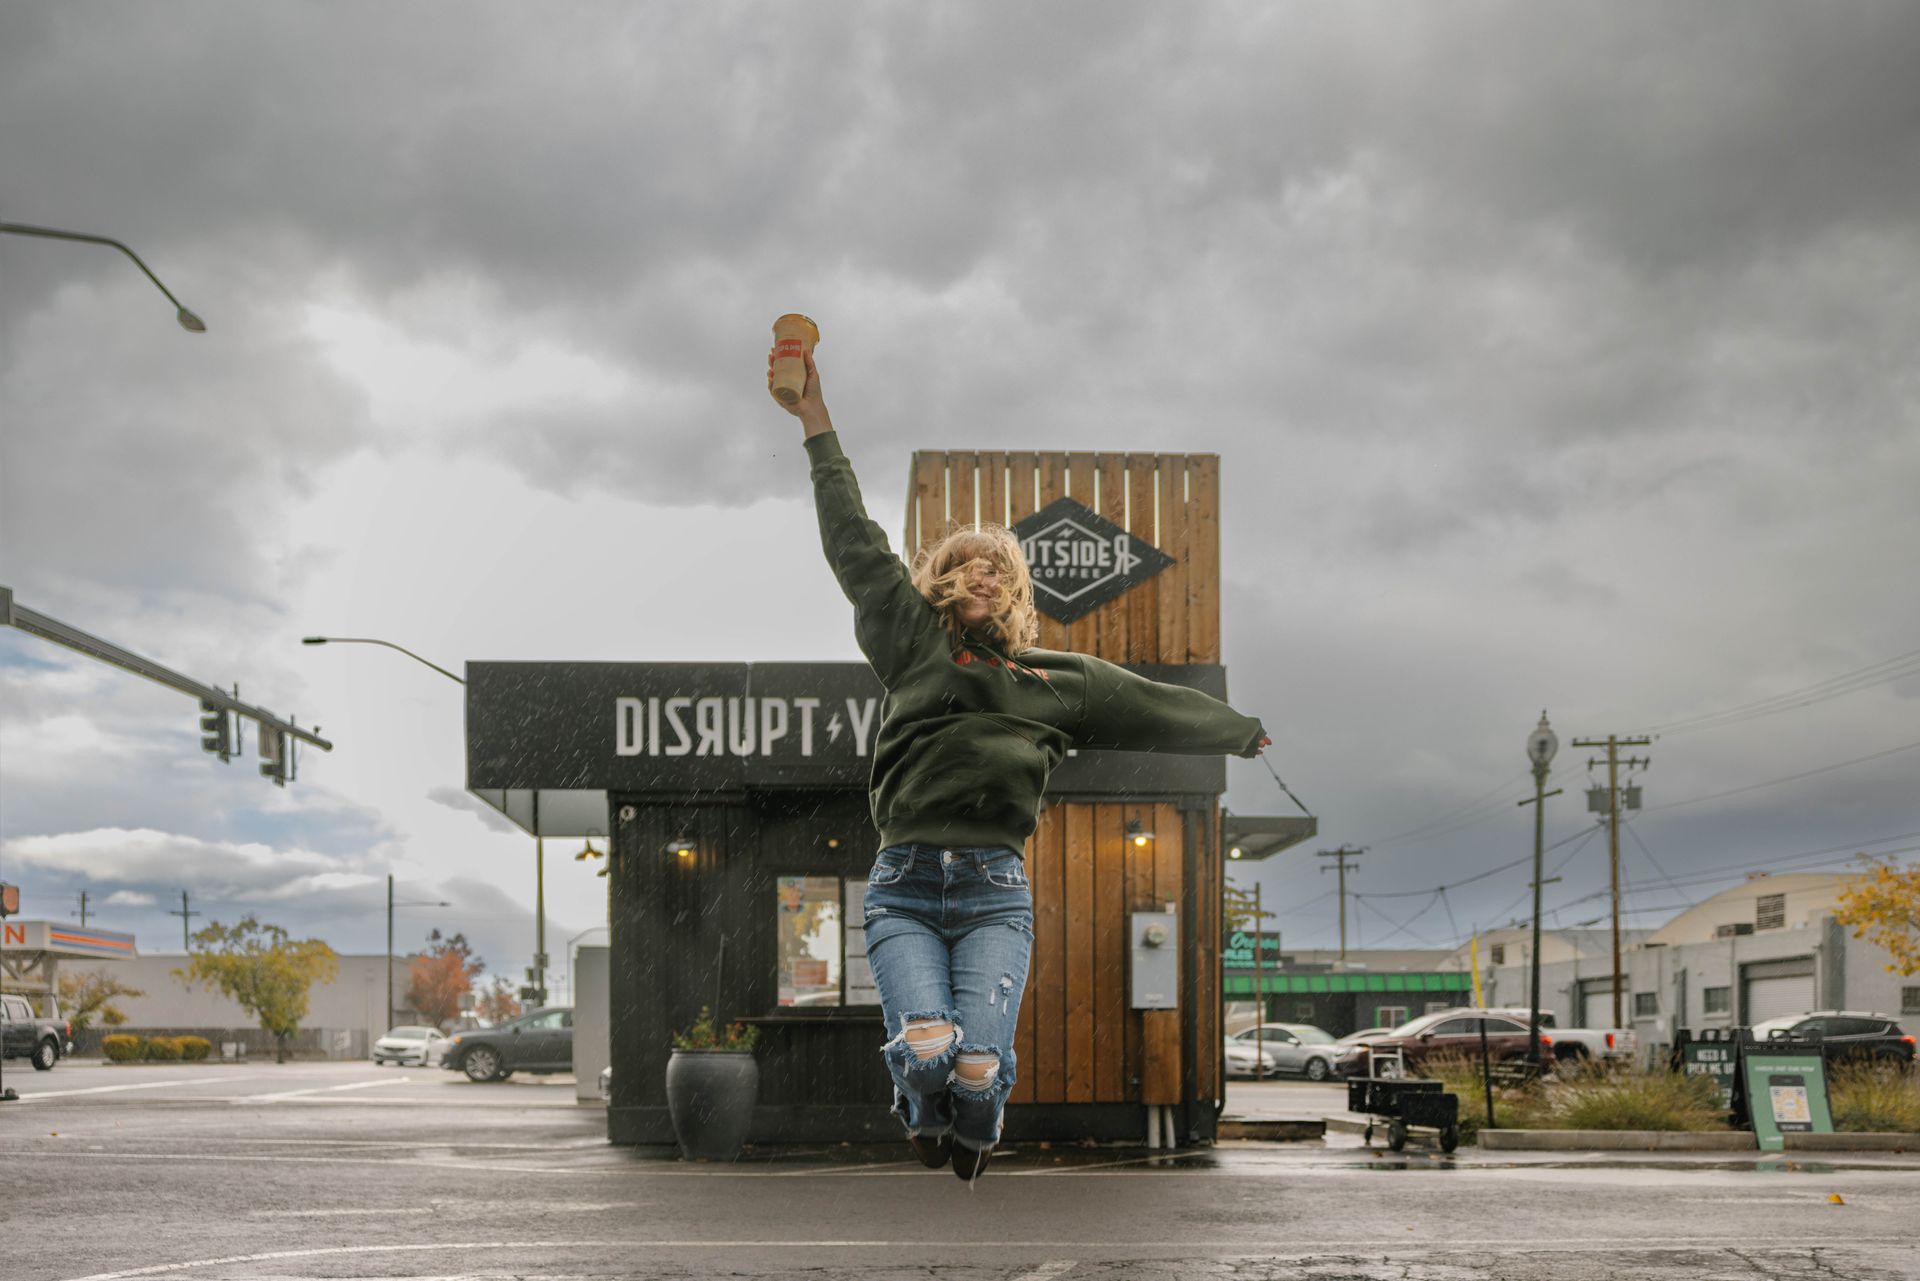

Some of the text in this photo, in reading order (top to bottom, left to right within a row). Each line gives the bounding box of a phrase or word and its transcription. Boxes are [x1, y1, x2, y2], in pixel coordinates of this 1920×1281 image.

[1020, 535, 1130, 575] UTSIDER
[1032, 567, 1100, 579] COFFEE
[615, 697, 877, 757] DISRUPT Y
[1696, 1048, 1729, 1061] NEED A
[1709, 1062, 1722, 1075] ME
